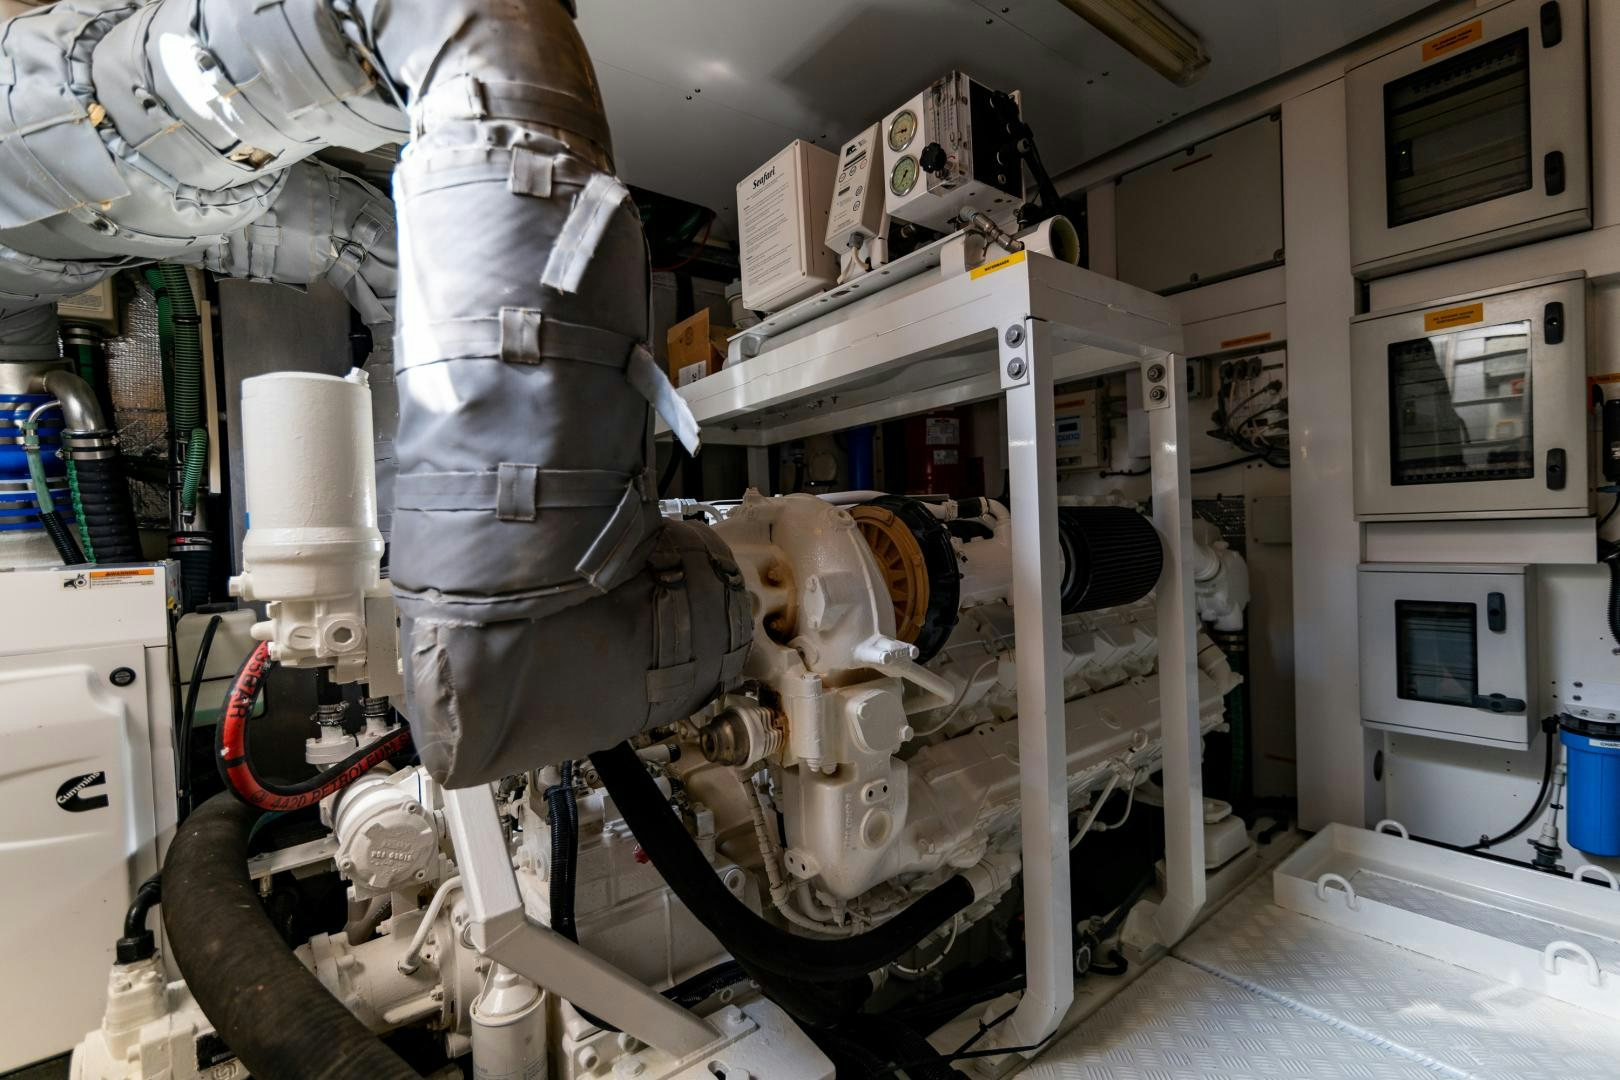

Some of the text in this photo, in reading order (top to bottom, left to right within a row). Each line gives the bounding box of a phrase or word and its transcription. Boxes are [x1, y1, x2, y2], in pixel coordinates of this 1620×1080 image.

[752, 165, 776, 190] Seafari
[57, 771, 101, 804] Cummins
[312, 743, 396, 803] PETROLEUM
